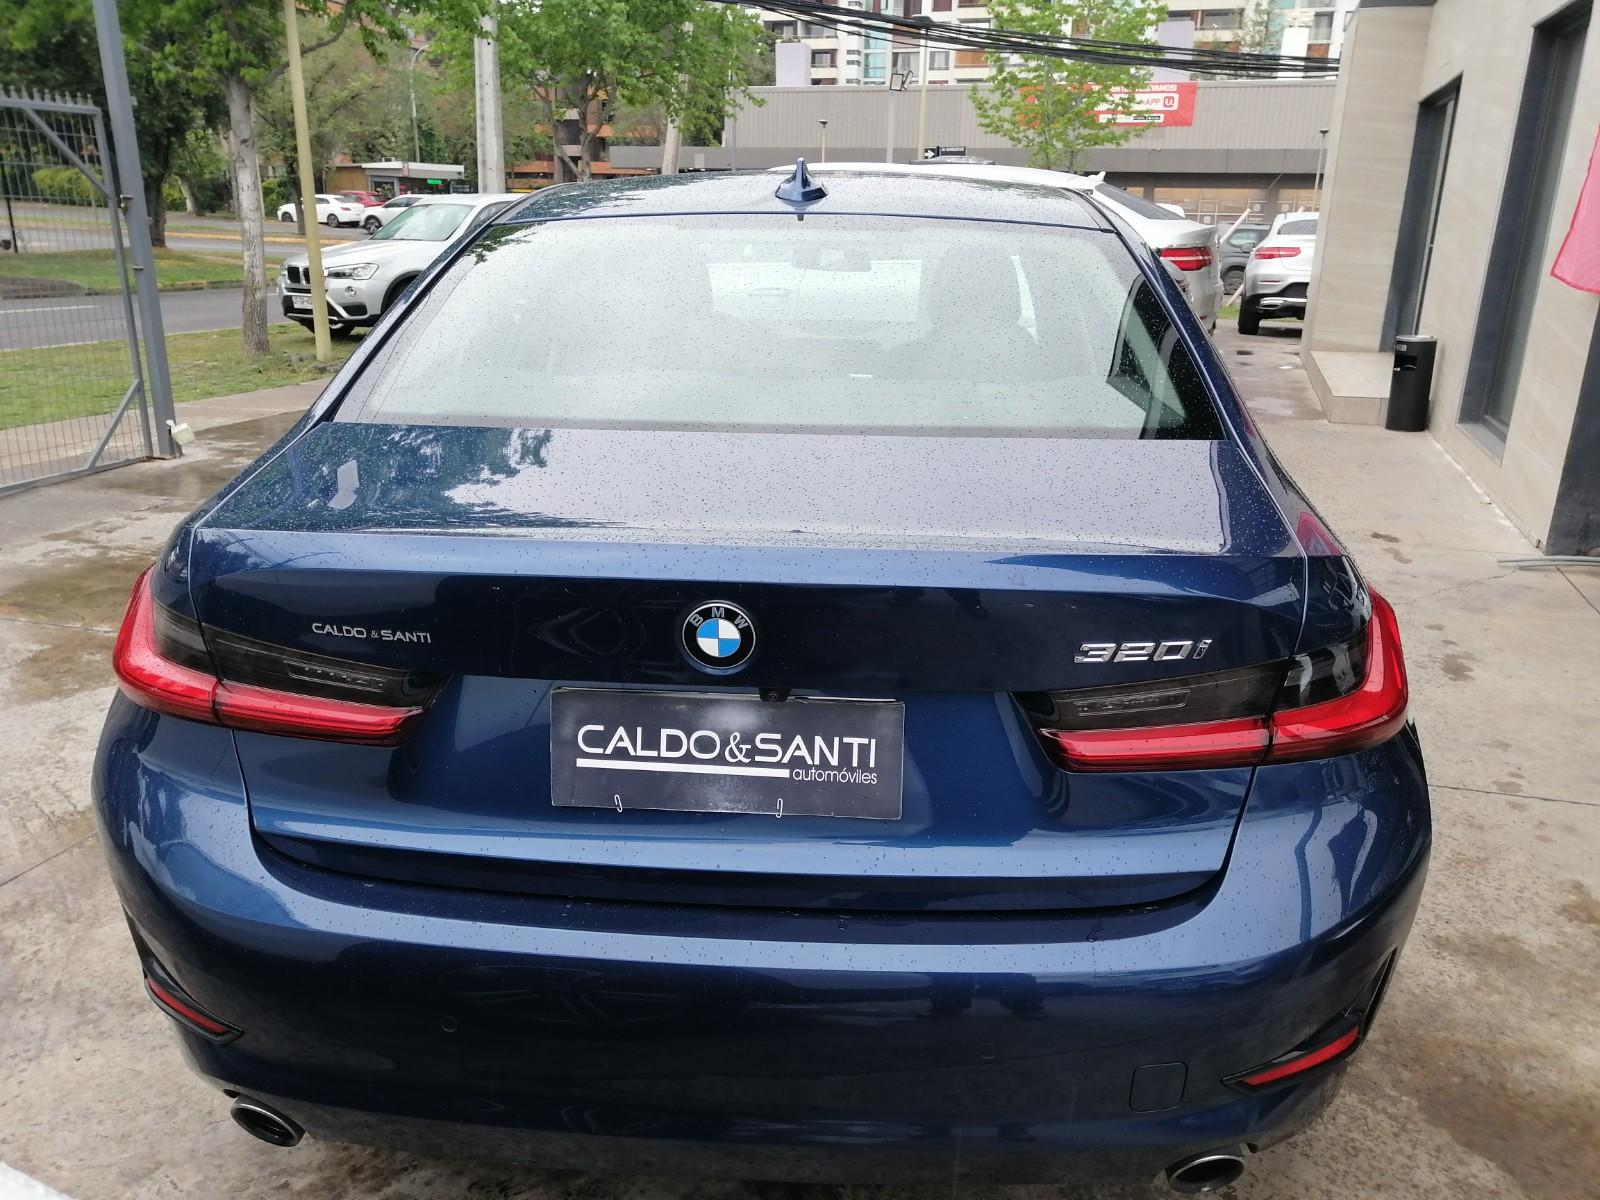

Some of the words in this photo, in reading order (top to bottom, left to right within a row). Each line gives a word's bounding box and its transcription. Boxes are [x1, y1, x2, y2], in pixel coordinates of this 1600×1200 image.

[689, 607, 749, 629] BMW
[311, 622, 367, 638] CALDO
[380, 629, 432, 644] SANTI
[1073, 639, 1213, 663] 320i
[792, 766, 879, 786] automóviles
